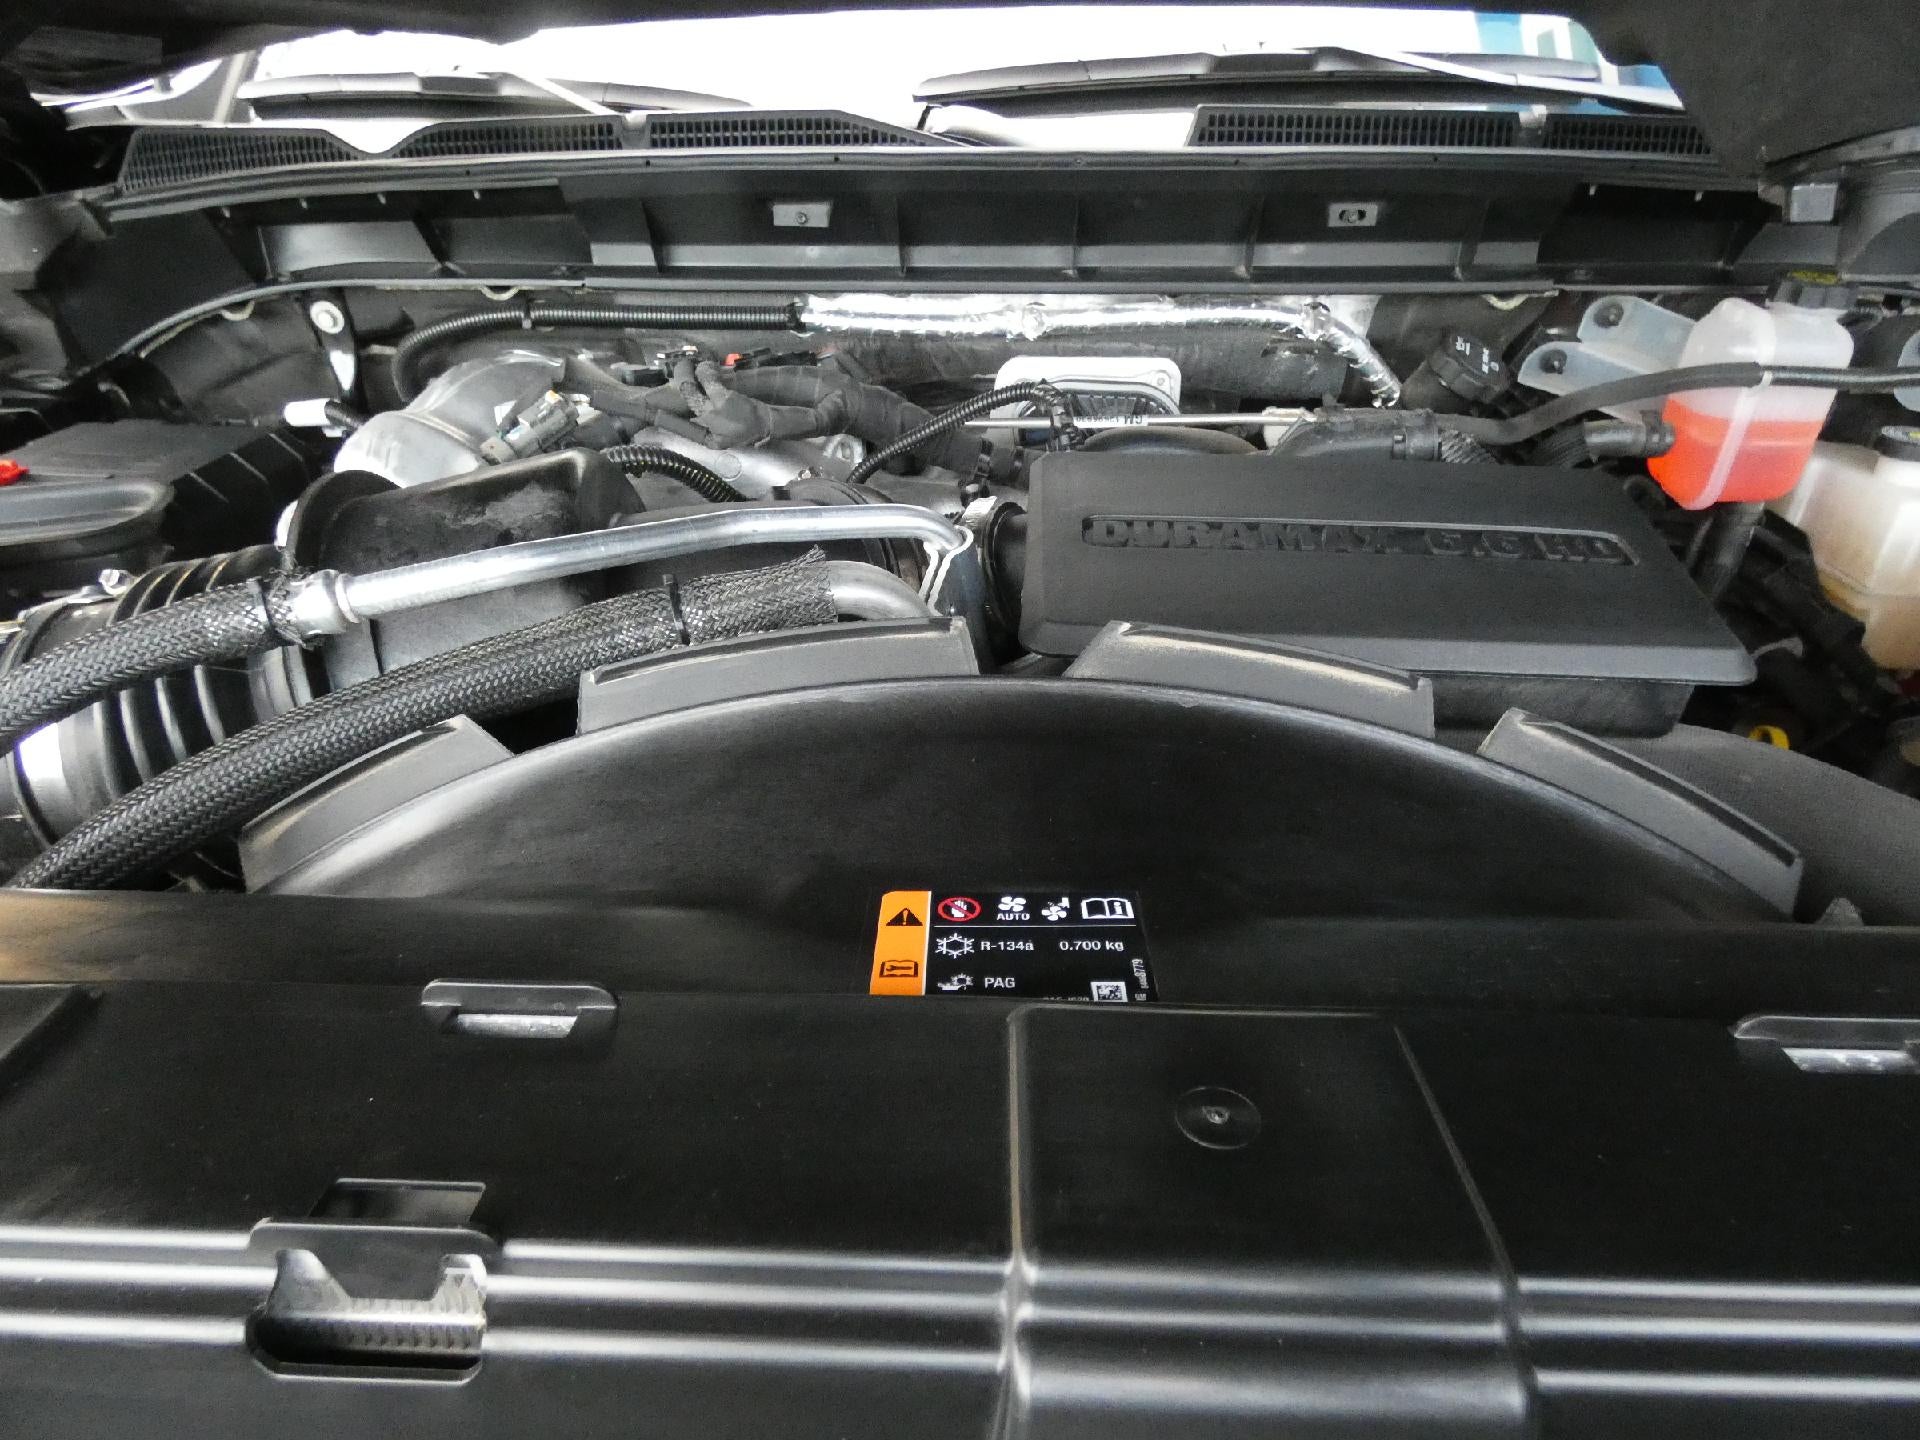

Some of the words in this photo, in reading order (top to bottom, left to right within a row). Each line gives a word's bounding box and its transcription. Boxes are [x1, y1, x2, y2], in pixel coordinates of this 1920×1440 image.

[997, 912, 1031, 921] AUTO
[981, 941, 1034, 951] R-134a
[1060, 940, 1101, 951] 0.700
[1105, 940, 1124, 952] kg
[984, 977, 1016, 989] PAG
